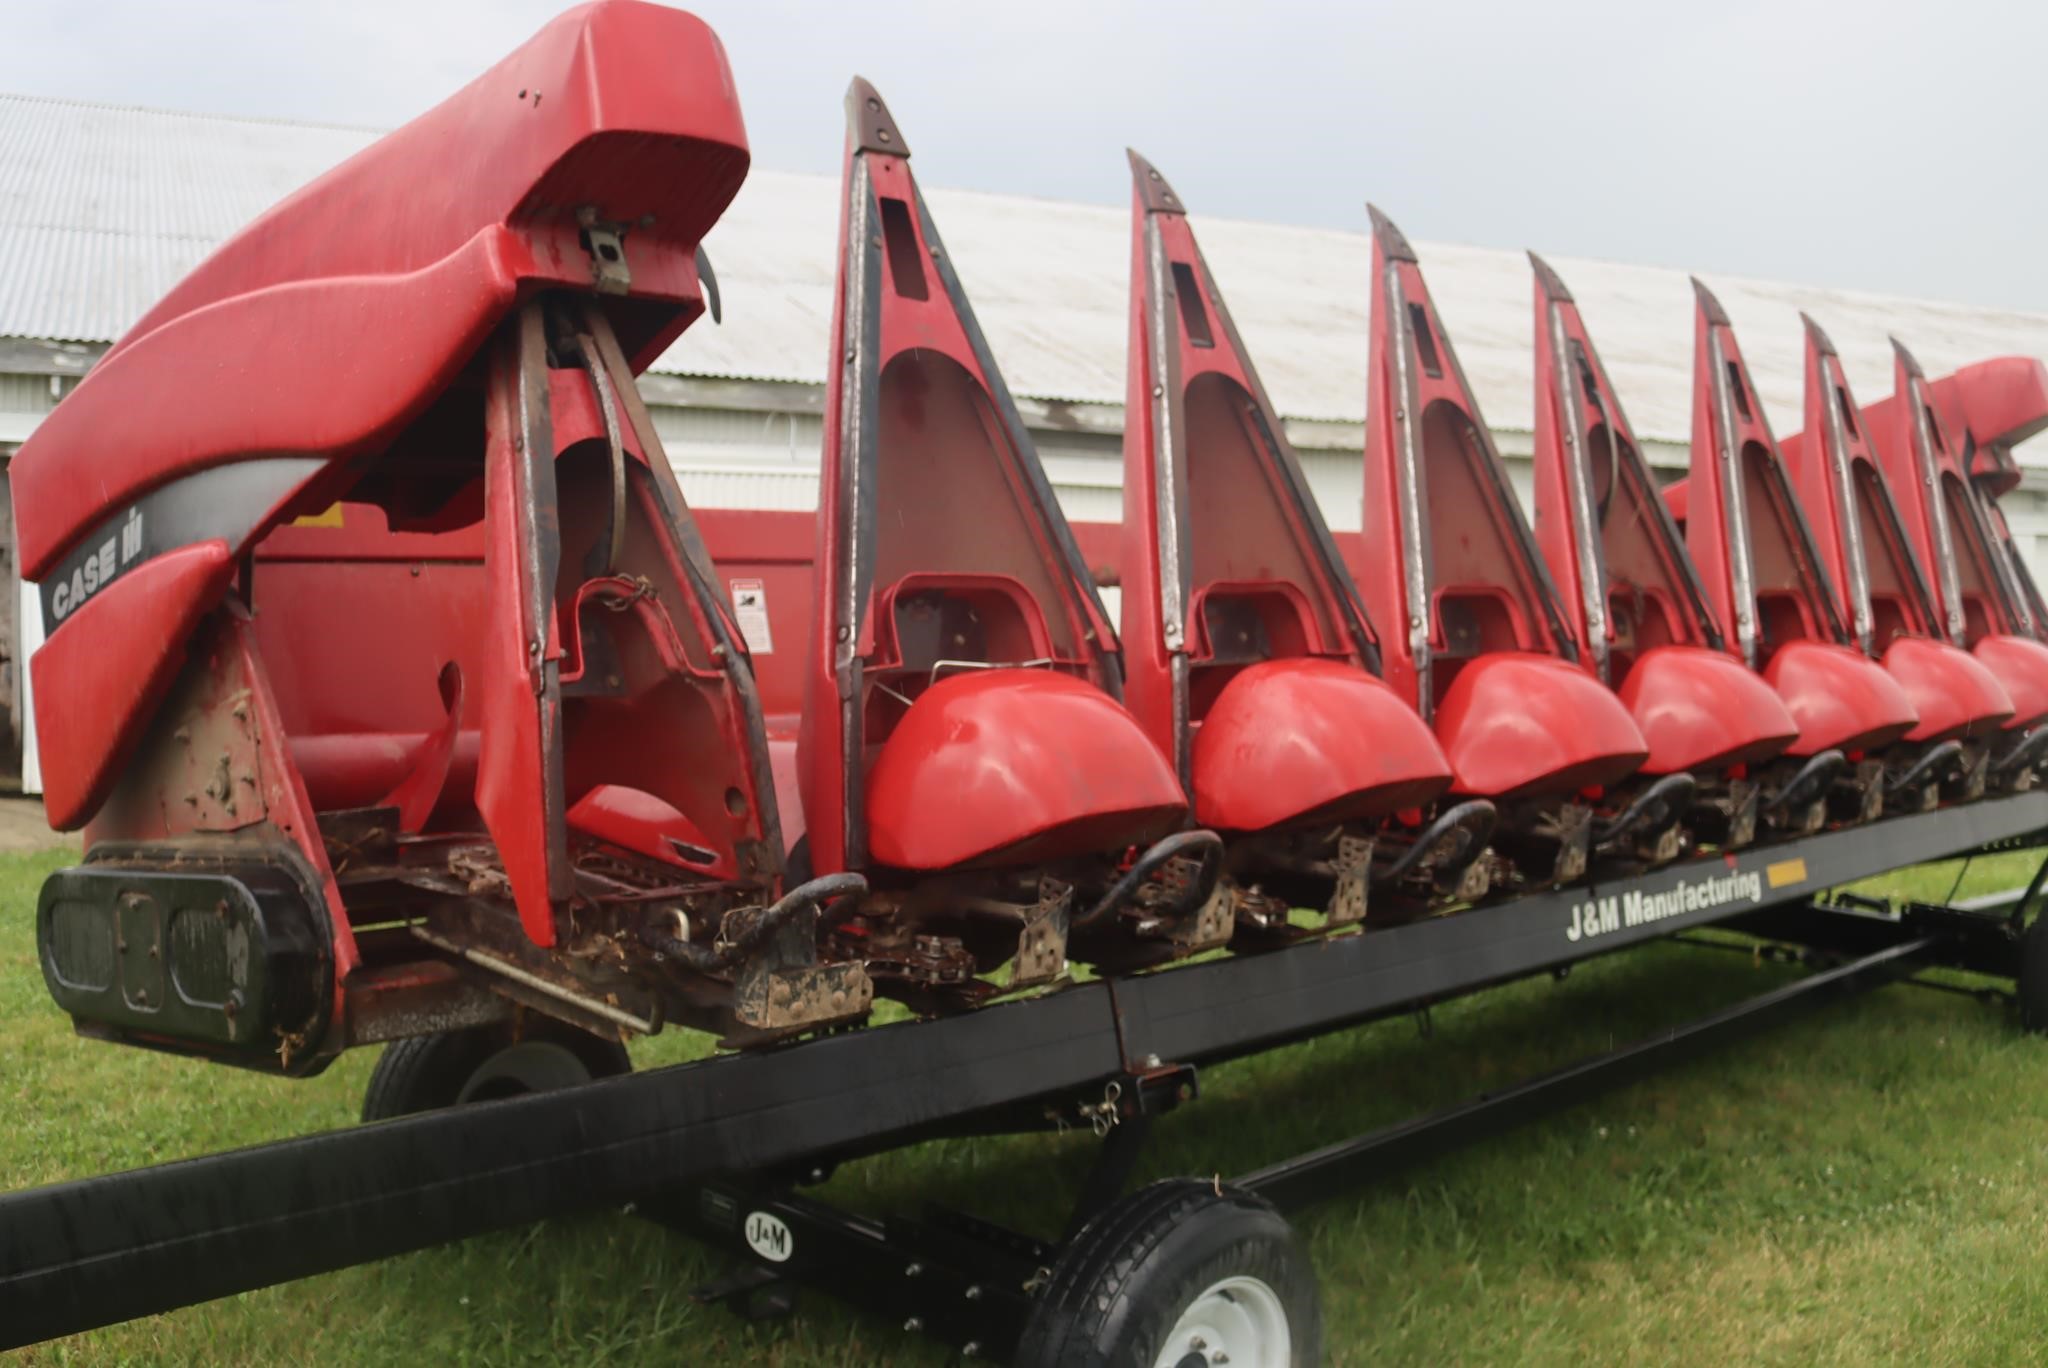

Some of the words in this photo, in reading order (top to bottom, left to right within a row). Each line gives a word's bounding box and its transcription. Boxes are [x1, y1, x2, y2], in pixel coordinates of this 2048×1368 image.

[52, 536, 115, 620] CASE
[1566, 896, 1619, 942] J&M
[1623, 869, 1762, 927] Manufacturing
[749, 1217, 785, 1254] J&M
